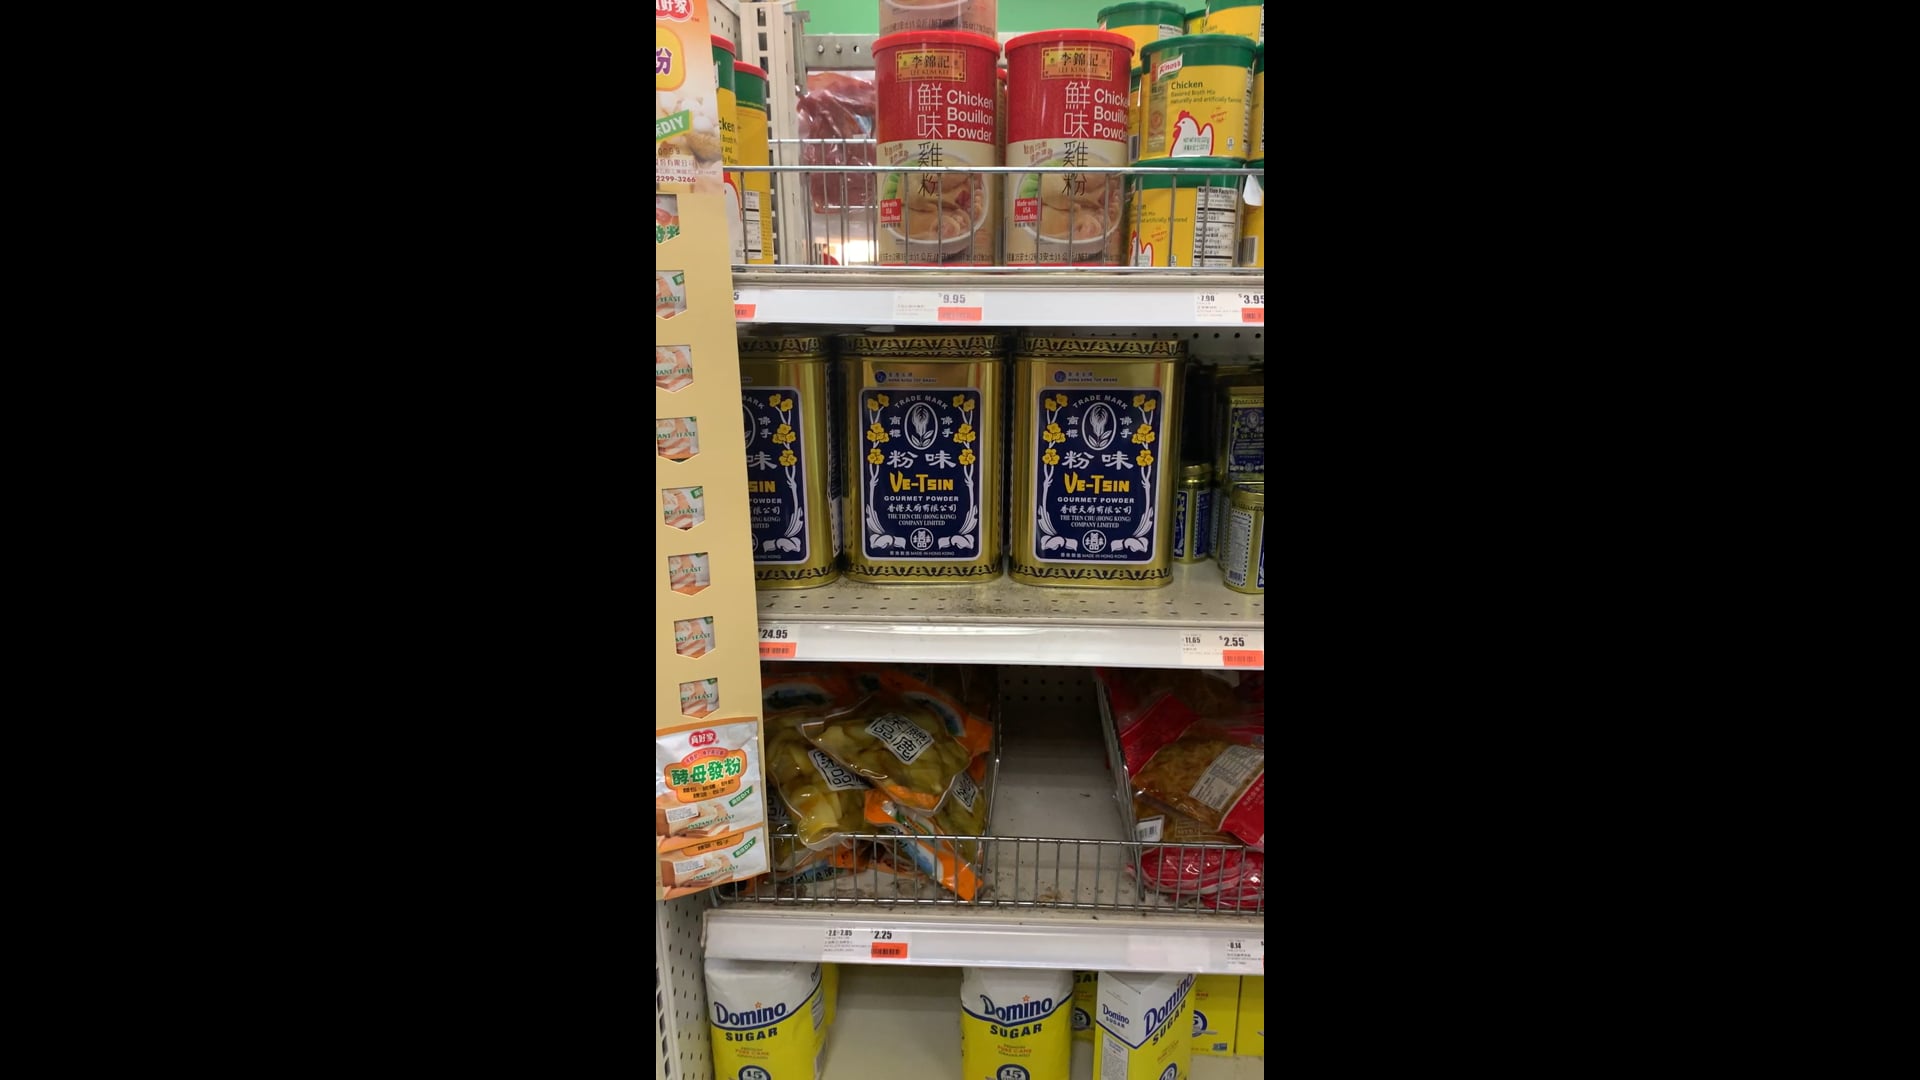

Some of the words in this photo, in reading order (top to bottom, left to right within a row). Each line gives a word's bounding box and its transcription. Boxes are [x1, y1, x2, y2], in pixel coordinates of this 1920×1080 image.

[1171, 80, 1203, 90] Chicken
[946, 89, 994, 111] Chicken
[946, 106, 994, 126] Bouillon
[946, 123, 993, 142] Powder
[895, 395, 922, 409] TRADE
[924, 395, 949, 410] MARK
[1072, 394, 1101, 409] TRADE
[1104, 395, 1129, 410] MARK
[671, 757, 741, 786] 酵母發粉
[714, 1001, 788, 1026] Domino
[980, 994, 1053, 1022] Domino
[1144, 972, 1193, 1037] Domino
[1102, 1003, 1130, 1026] Domino
[1105, 1016, 1126, 1029] SUGAR
[1152, 999, 1187, 1046] SUGAR
[725, 1027, 778, 1041] SUGAR
[990, 1023, 1043, 1039] SUGAR
[746, 1070, 763, 1079] 15
[1006, 1069, 1022, 1079] 15
